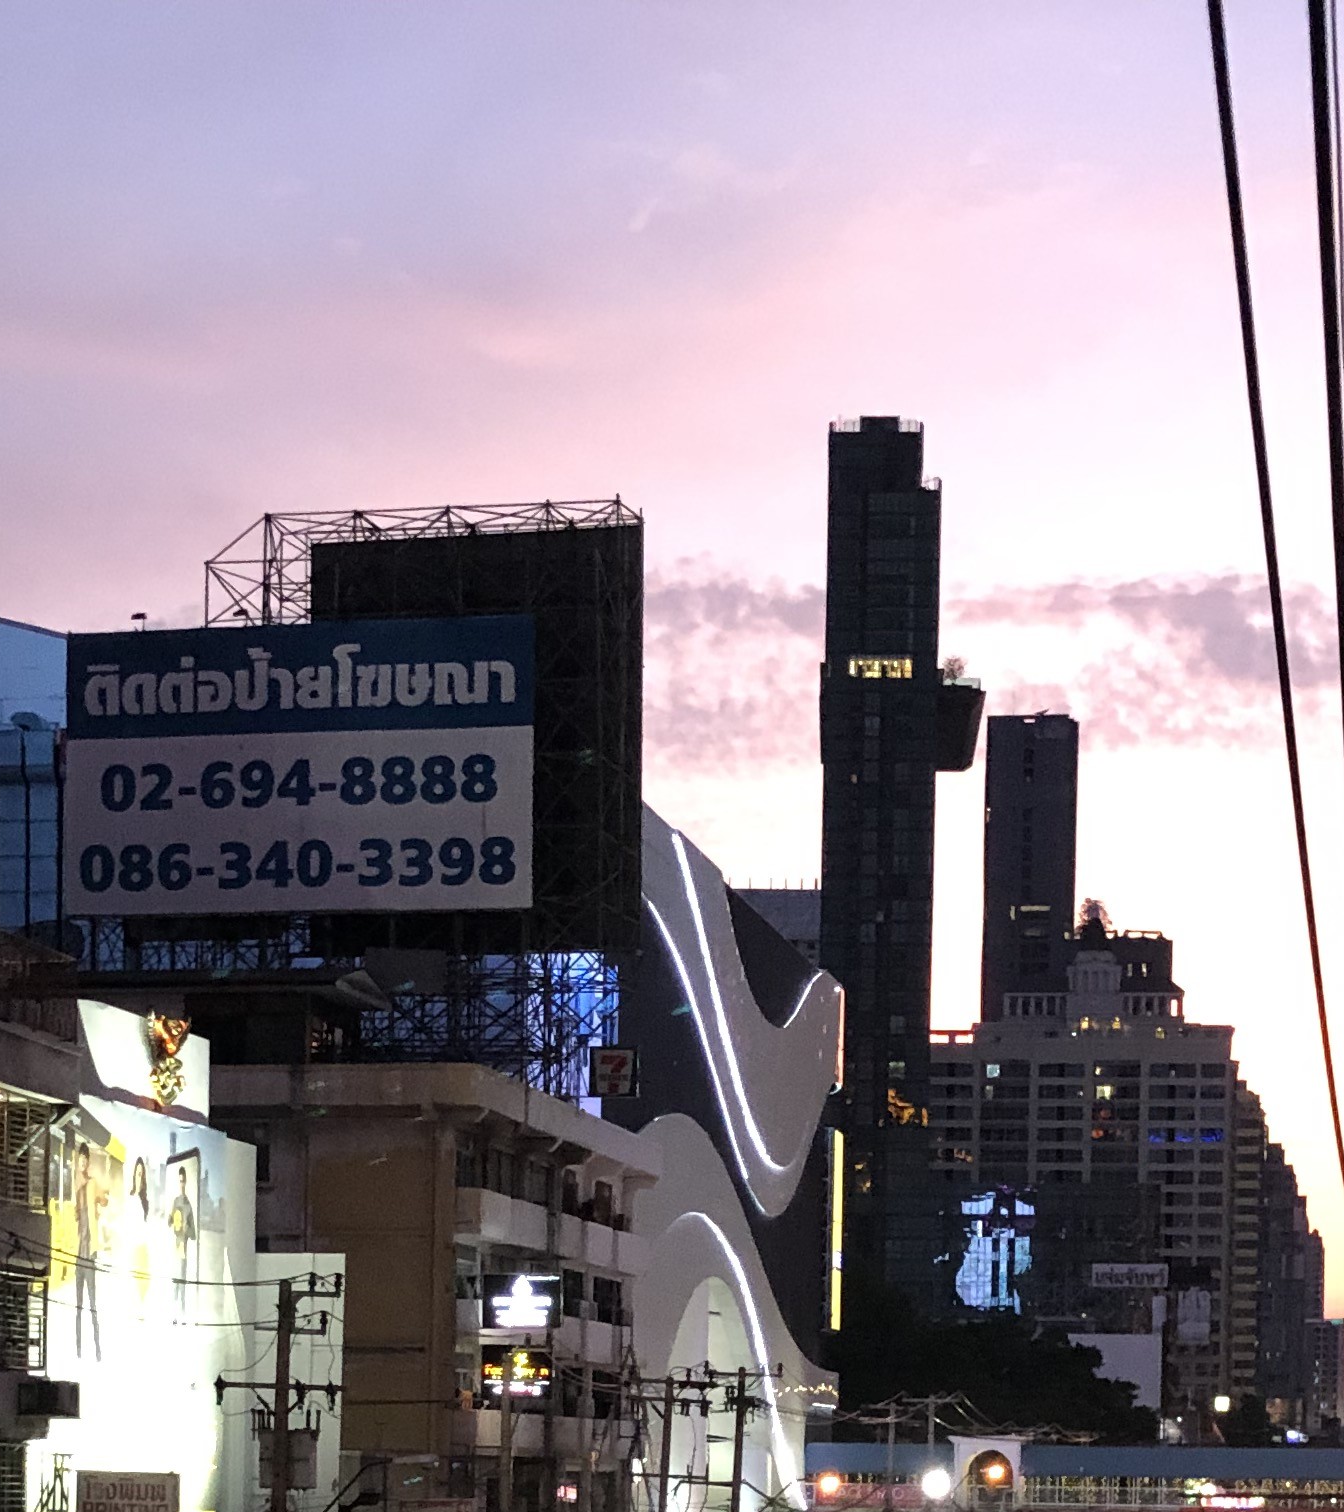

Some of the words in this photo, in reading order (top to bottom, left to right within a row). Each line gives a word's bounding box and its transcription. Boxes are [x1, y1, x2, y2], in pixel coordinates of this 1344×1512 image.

[84, 642, 516, 716] ติดต่อป้ายโฆษณา
[99, 753, 499, 813] 02-694-8888
[79, 835, 517, 892] 086-340-3398
